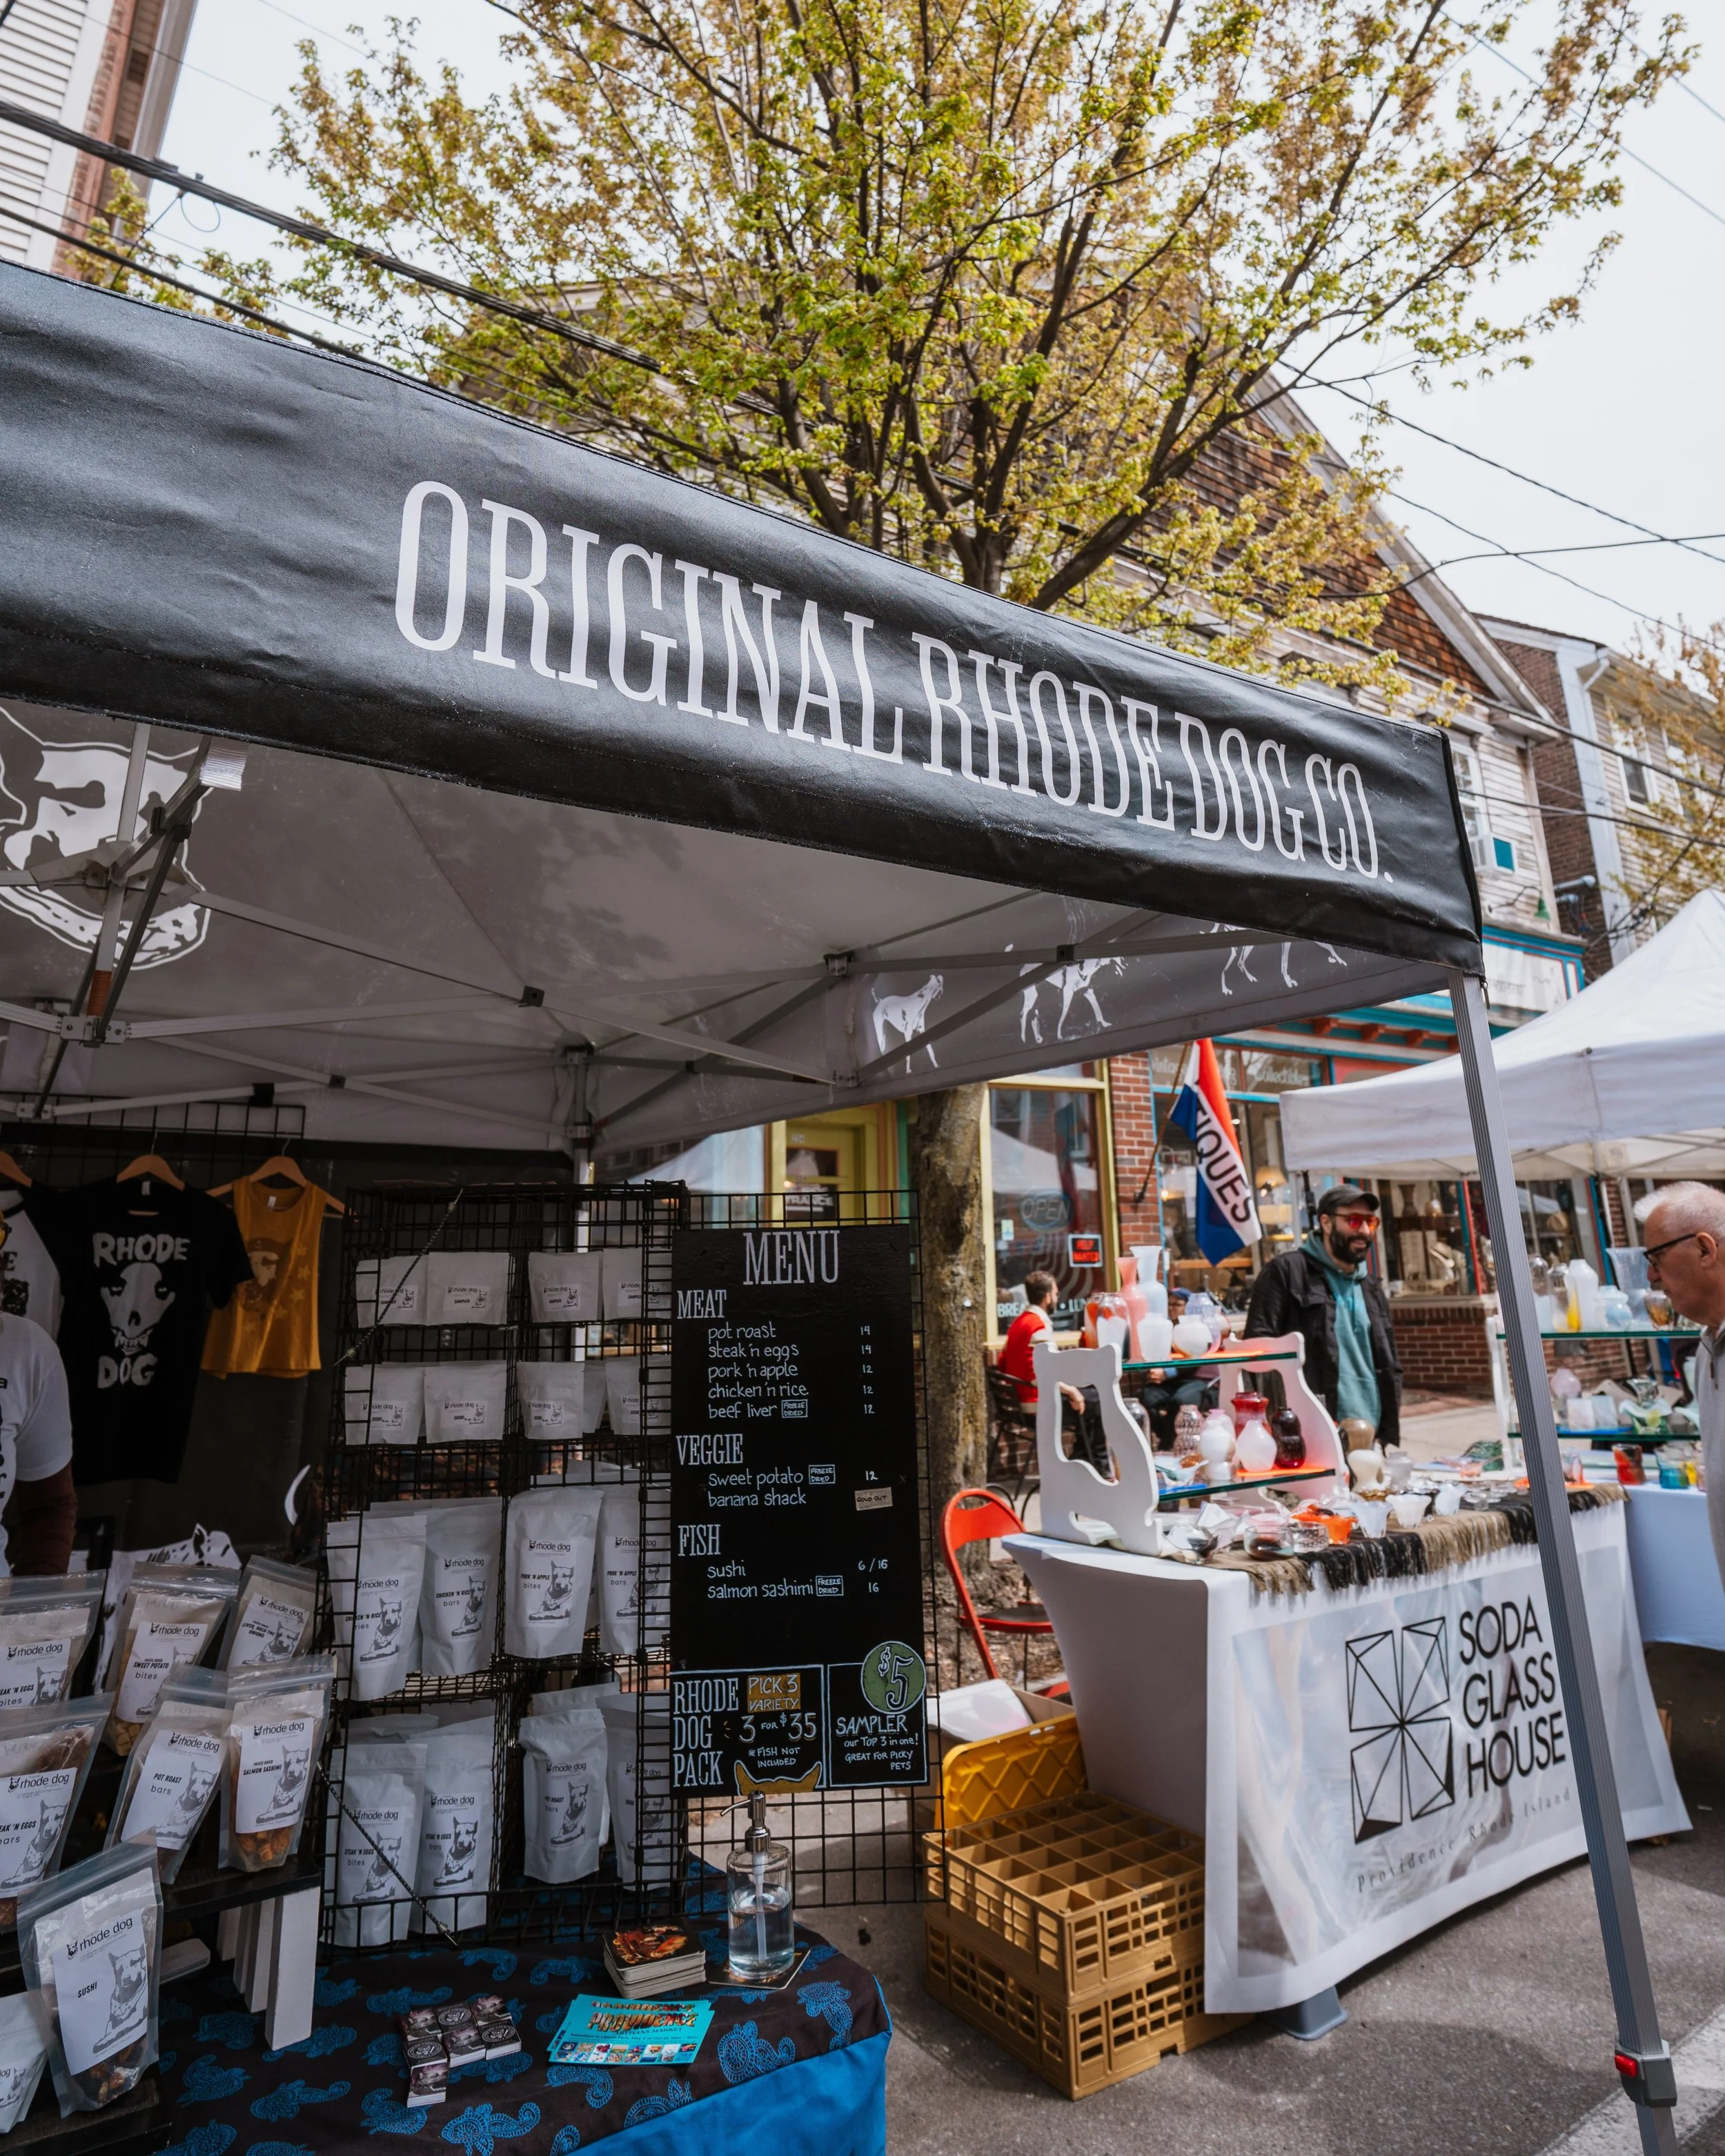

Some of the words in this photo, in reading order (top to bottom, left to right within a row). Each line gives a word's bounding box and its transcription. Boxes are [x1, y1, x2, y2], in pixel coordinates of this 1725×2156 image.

[395, 480, 905, 766] ORIGINAL
[911, 632, 1174, 832] RHODE
[1174, 711, 1306, 861] DOG
[1305, 753, 1393, 883] CO.
[1196, 1097, 1251, 1223] TIQUES
[1021, 1198, 1068, 1220] OPEN
[92, 1233, 190, 1267] RHODE
[743, 1230, 840, 1285] MENU
[677, 1289, 727, 1319] MEAT
[709, 1322, 733, 1344] pot
[736, 1321, 776, 1338] roast
[860, 1326, 870, 1336] 14
[709, 1341, 747, 1358] steak
[764, 1345, 799, 1361] eggs
[862, 1345, 871, 1354] 14
[97, 1354, 157, 1389] DOG
[709, 1363, 742, 1383] pork
[760, 1362, 798, 1380] apple
[862, 1365, 873, 1374] 12
[709, 1381, 762, 1398] chicken
[780, 1383, 809, 1396] rice
[863, 1385, 874, 1394] 12
[709, 1402, 742, 1418] beef
[747, 1403, 777, 1418] liver
[864, 1405, 875, 1414] 12
[676, 1434, 743, 1465] VEGGIE
[709, 1468, 751, 1487] sweet
[757, 1466, 803, 1490] potato
[865, 1470, 878, 1481] 12
[708, 1491, 758, 1507] banana
[764, 1487, 806, 1505] shack
[535, 1541, 556, 1550] rhode
[557, 1543, 571, 1552] dog
[678, 1524, 721, 1556] FISH
[452, 1558, 472, 1567] rhode
[473, 1557, 484, 1567] dog
[707, 1560, 746, 1578] sushi
[362, 1579, 384, 1589] rhode
[384, 1579, 399, 1588] dog
[707, 1584, 757, 1599] salmon
[762, 1578, 813, 1597] sashimi
[869, 1583, 879, 1592] 16
[268, 1600, 288, 1613] rhode
[289, 1608, 304, 1619] dog
[158, 1626, 182, 1635] rhode
[184, 1626, 199, 1636] dog
[1459, 1595, 1543, 1665] SODA
[17, 1645, 43, 1656] rhode
[46, 1643, 63, 1654] dog
[749, 1677, 782, 1695] PICK
[786, 1674, 798, 1692] 3
[878, 1646, 914, 1710] $5
[19, 1685, 34, 1693] EGGS
[673, 1678, 738, 1714] RHODE
[1463, 1652, 1557, 1729] GLASS
[749, 1698, 799, 1711] VARIETY
[263, 1722, 287, 1735] rhode
[289, 1721, 304, 1732] dog
[673, 1716, 713, 1750] DOG
[740, 1715, 756, 1743] 3
[836, 1714, 908, 1736] SAMPLER
[178, 1735, 202, 1748] rhode
[204, 1740, 219, 1753] dog
[844, 1739, 858, 1748] our
[860, 1737, 878, 1746] TOP
[880, 1737, 887, 1746] 3
[889, 1737, 898, 1745] in
[899, 1733, 918, 1745] one!
[782, 1747, 800, 1756] NOT
[845, 1753, 871, 1763] GREAT
[874, 1752, 888, 1760] FOR
[890, 1750, 913, 1759] PICKY
[1466, 1711, 1566, 1798] HOUSE
[243, 1767, 262, 1776] SALMON
[263, 1764, 282, 1772] SASHIMI
[553, 1763, 572, 1772] rhode
[573, 1762, 586, 1771] dog
[673, 1751, 723, 1787] PACK
[758, 1758, 796, 1768] INCLUDED
[891, 1762, 911, 1770] PETS
[20, 1775, 48, 1789] rhode
[52, 1774, 69, 1785] dog
[153, 1773, 164, 1781] POT
[165, 1775, 182, 1783] ROAST
[150, 1785, 172, 1795] bars
[437, 1797, 458, 1806] rhode
[460, 1796, 474, 1806] dog
[21, 1821, 37, 1830] EGGS
[361, 1811, 382, 1821] rhode
[384, 1810, 398, 1821] dog
[1357, 1838, 1456, 1892] Providence
[1468, 1813, 1515, 1841] Rhode
[1524, 1787, 1570, 1817] Island
[79, 1929, 110, 1951] rhode
[113, 1917, 132, 1934] dog
[78, 1981, 97, 1998] SUSHI
[587, 2012, 698, 2032] PROVIDENCE
